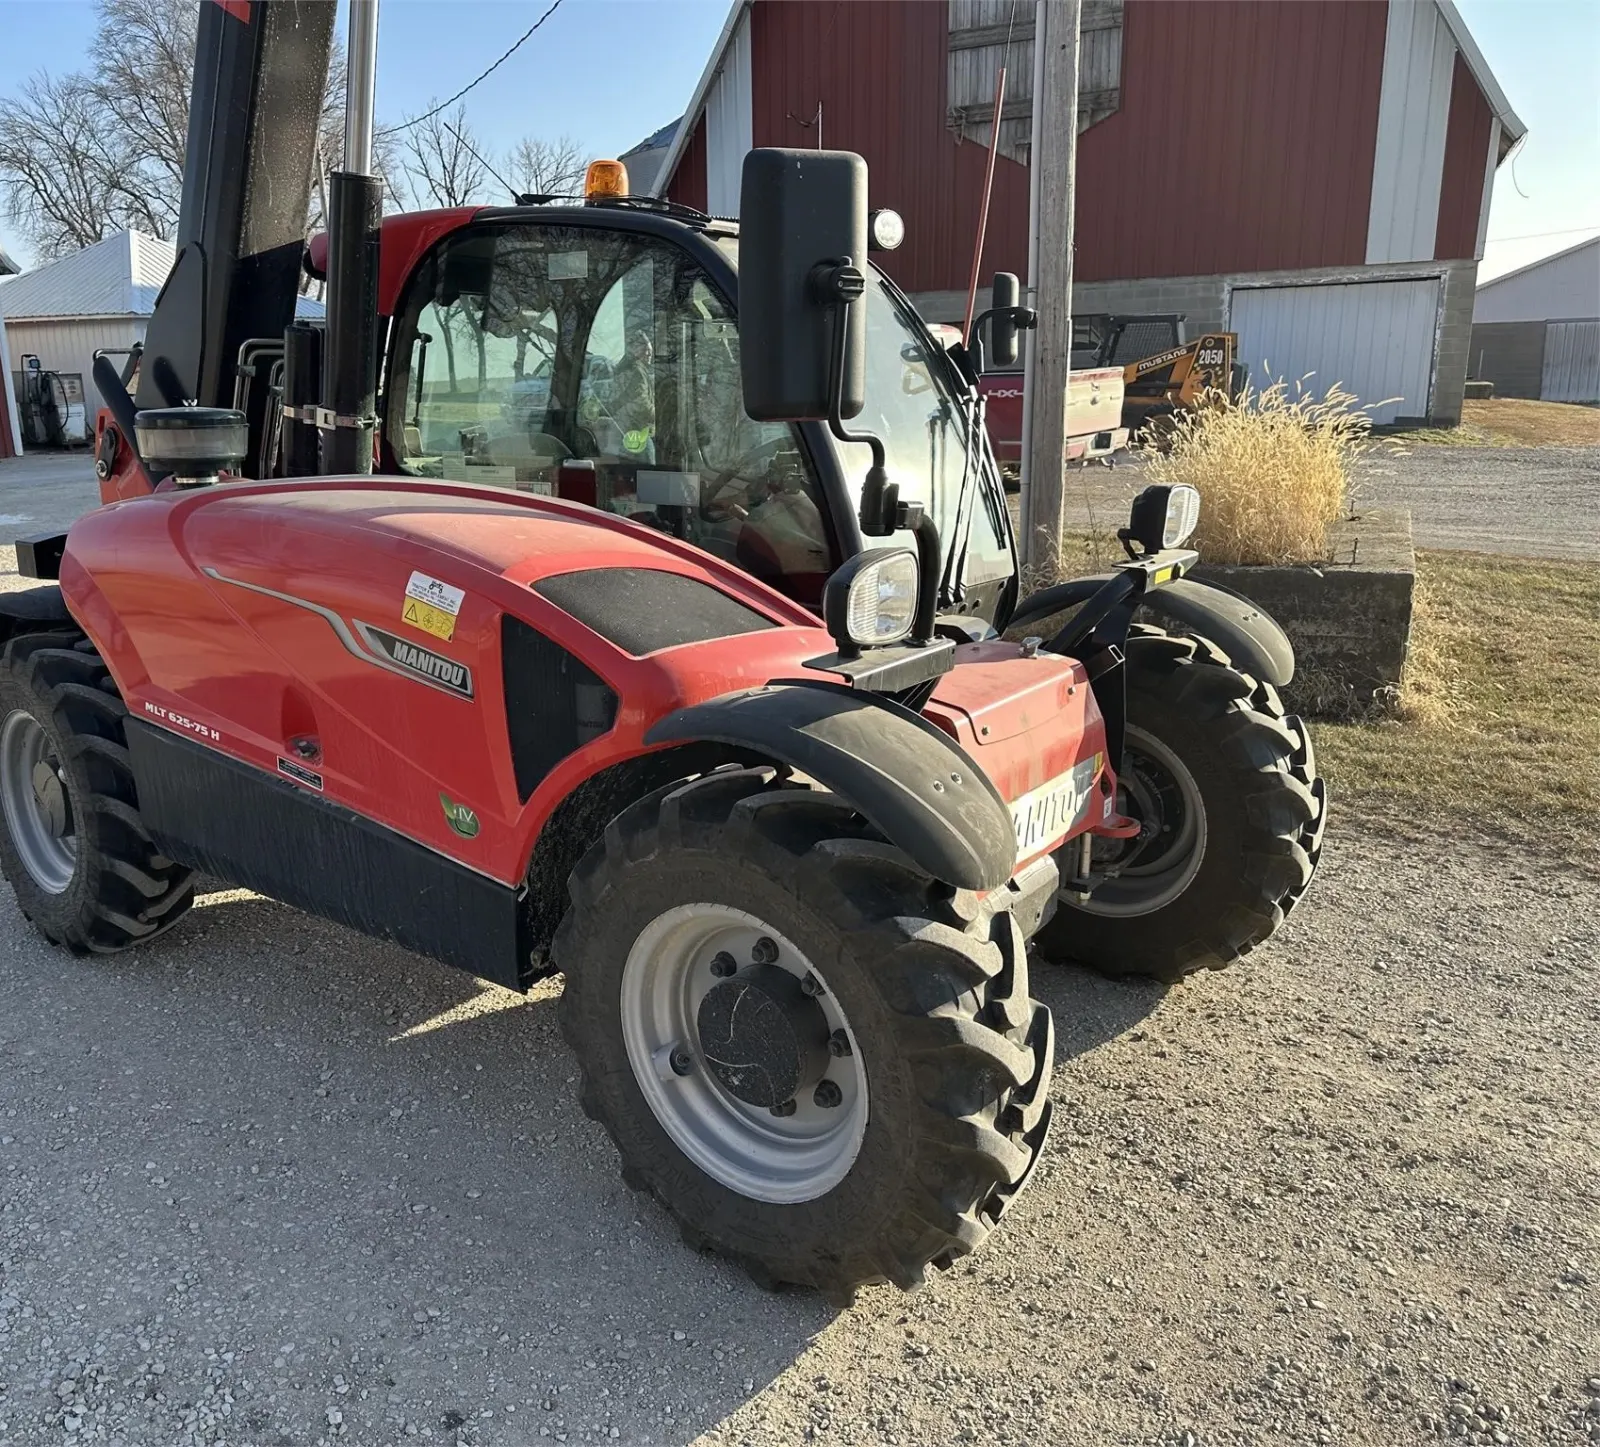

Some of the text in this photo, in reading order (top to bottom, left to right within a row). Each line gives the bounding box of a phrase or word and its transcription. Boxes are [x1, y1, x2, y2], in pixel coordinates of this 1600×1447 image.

[1139, 348, 1188, 371] MUSTANG
[1199, 349, 1224, 365] 2050
[393, 641, 464, 686] MANITOU
[145, 702, 220, 741] MLT 625-75 H
